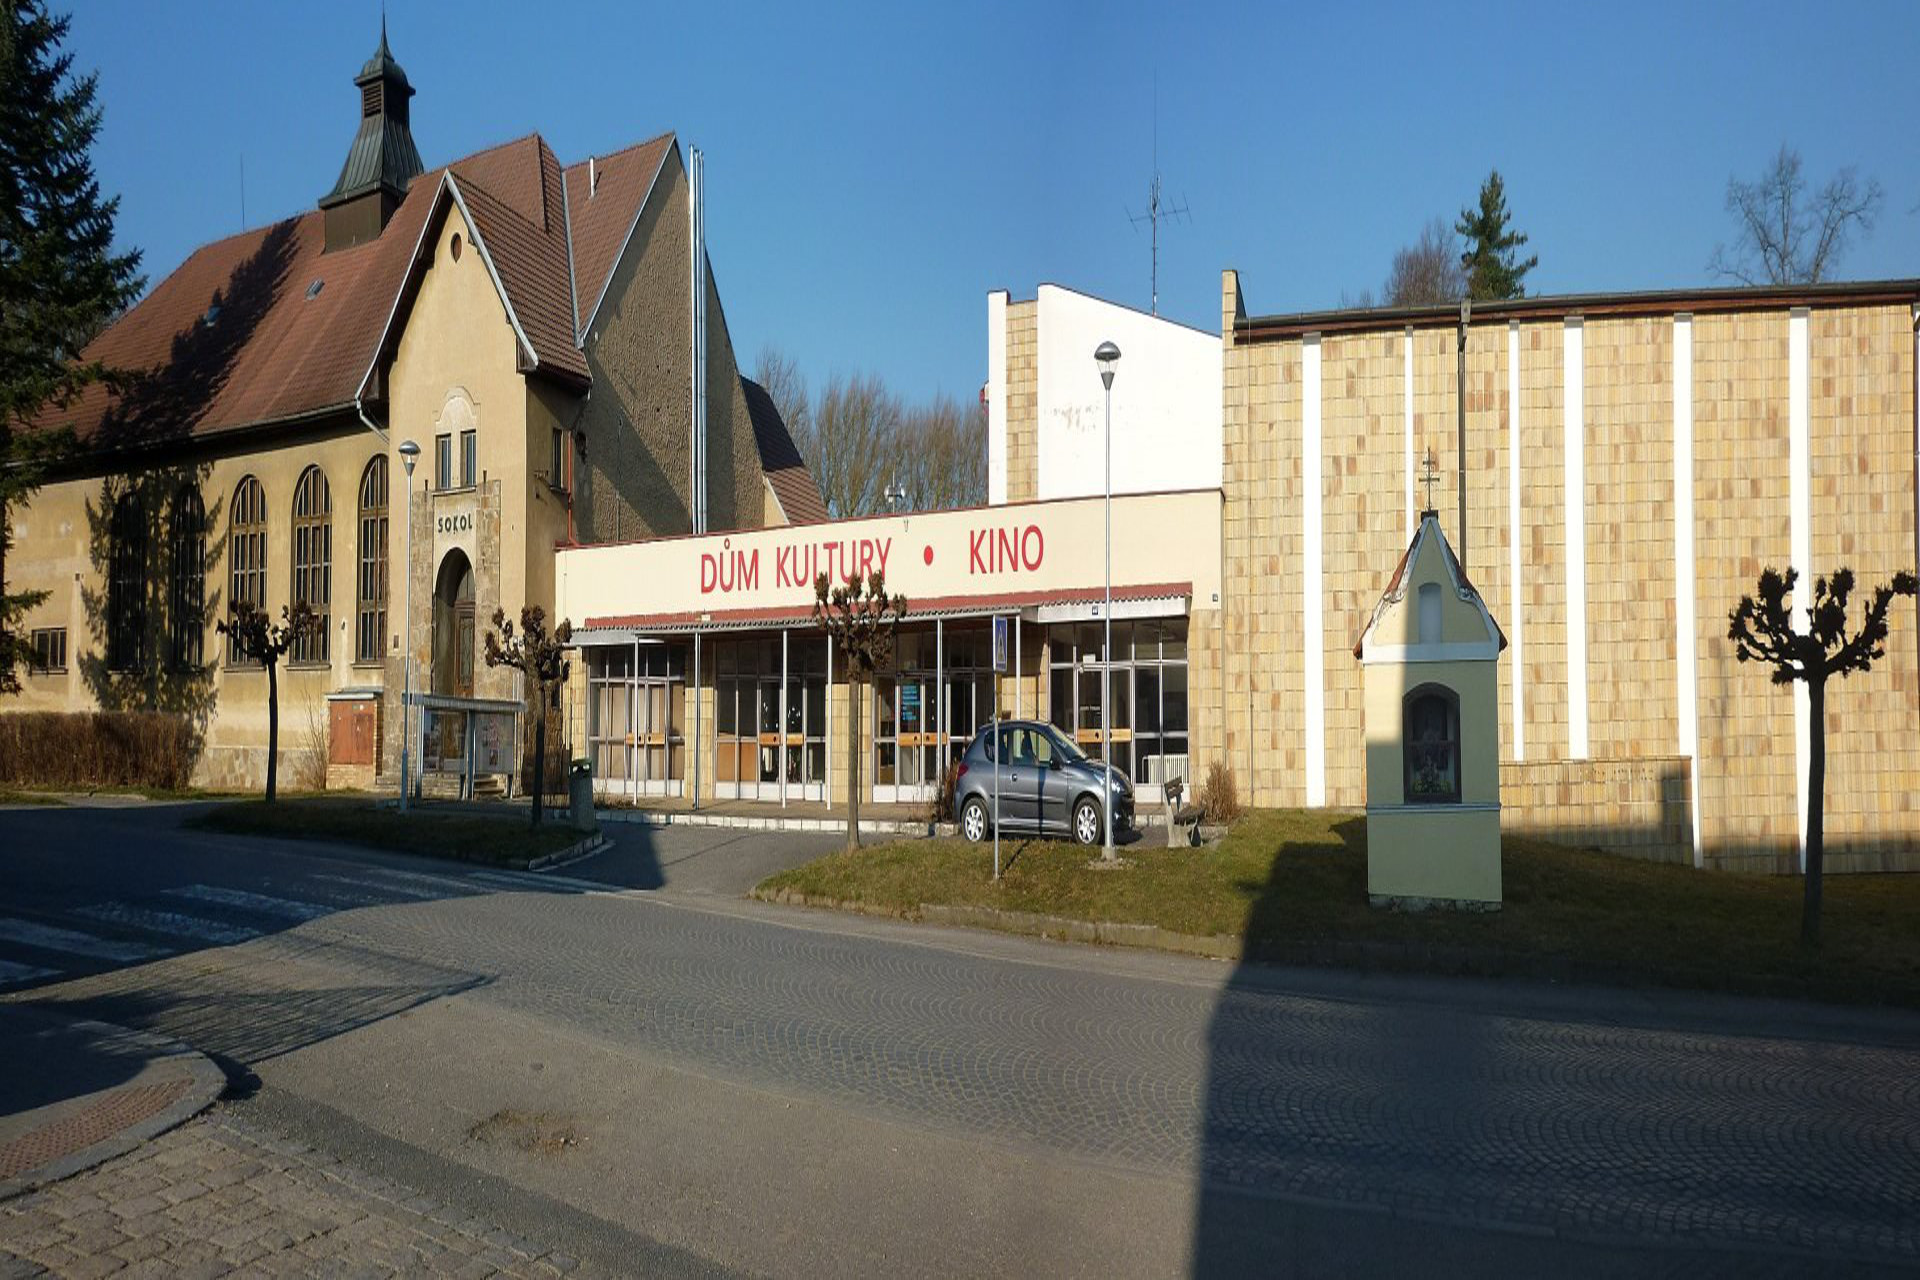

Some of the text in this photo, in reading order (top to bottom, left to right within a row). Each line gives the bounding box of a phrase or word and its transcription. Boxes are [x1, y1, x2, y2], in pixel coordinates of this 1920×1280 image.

[438, 513, 472, 534] SOKOL
[701, 524, 1044, 594] DŮM KULTURY KINO
